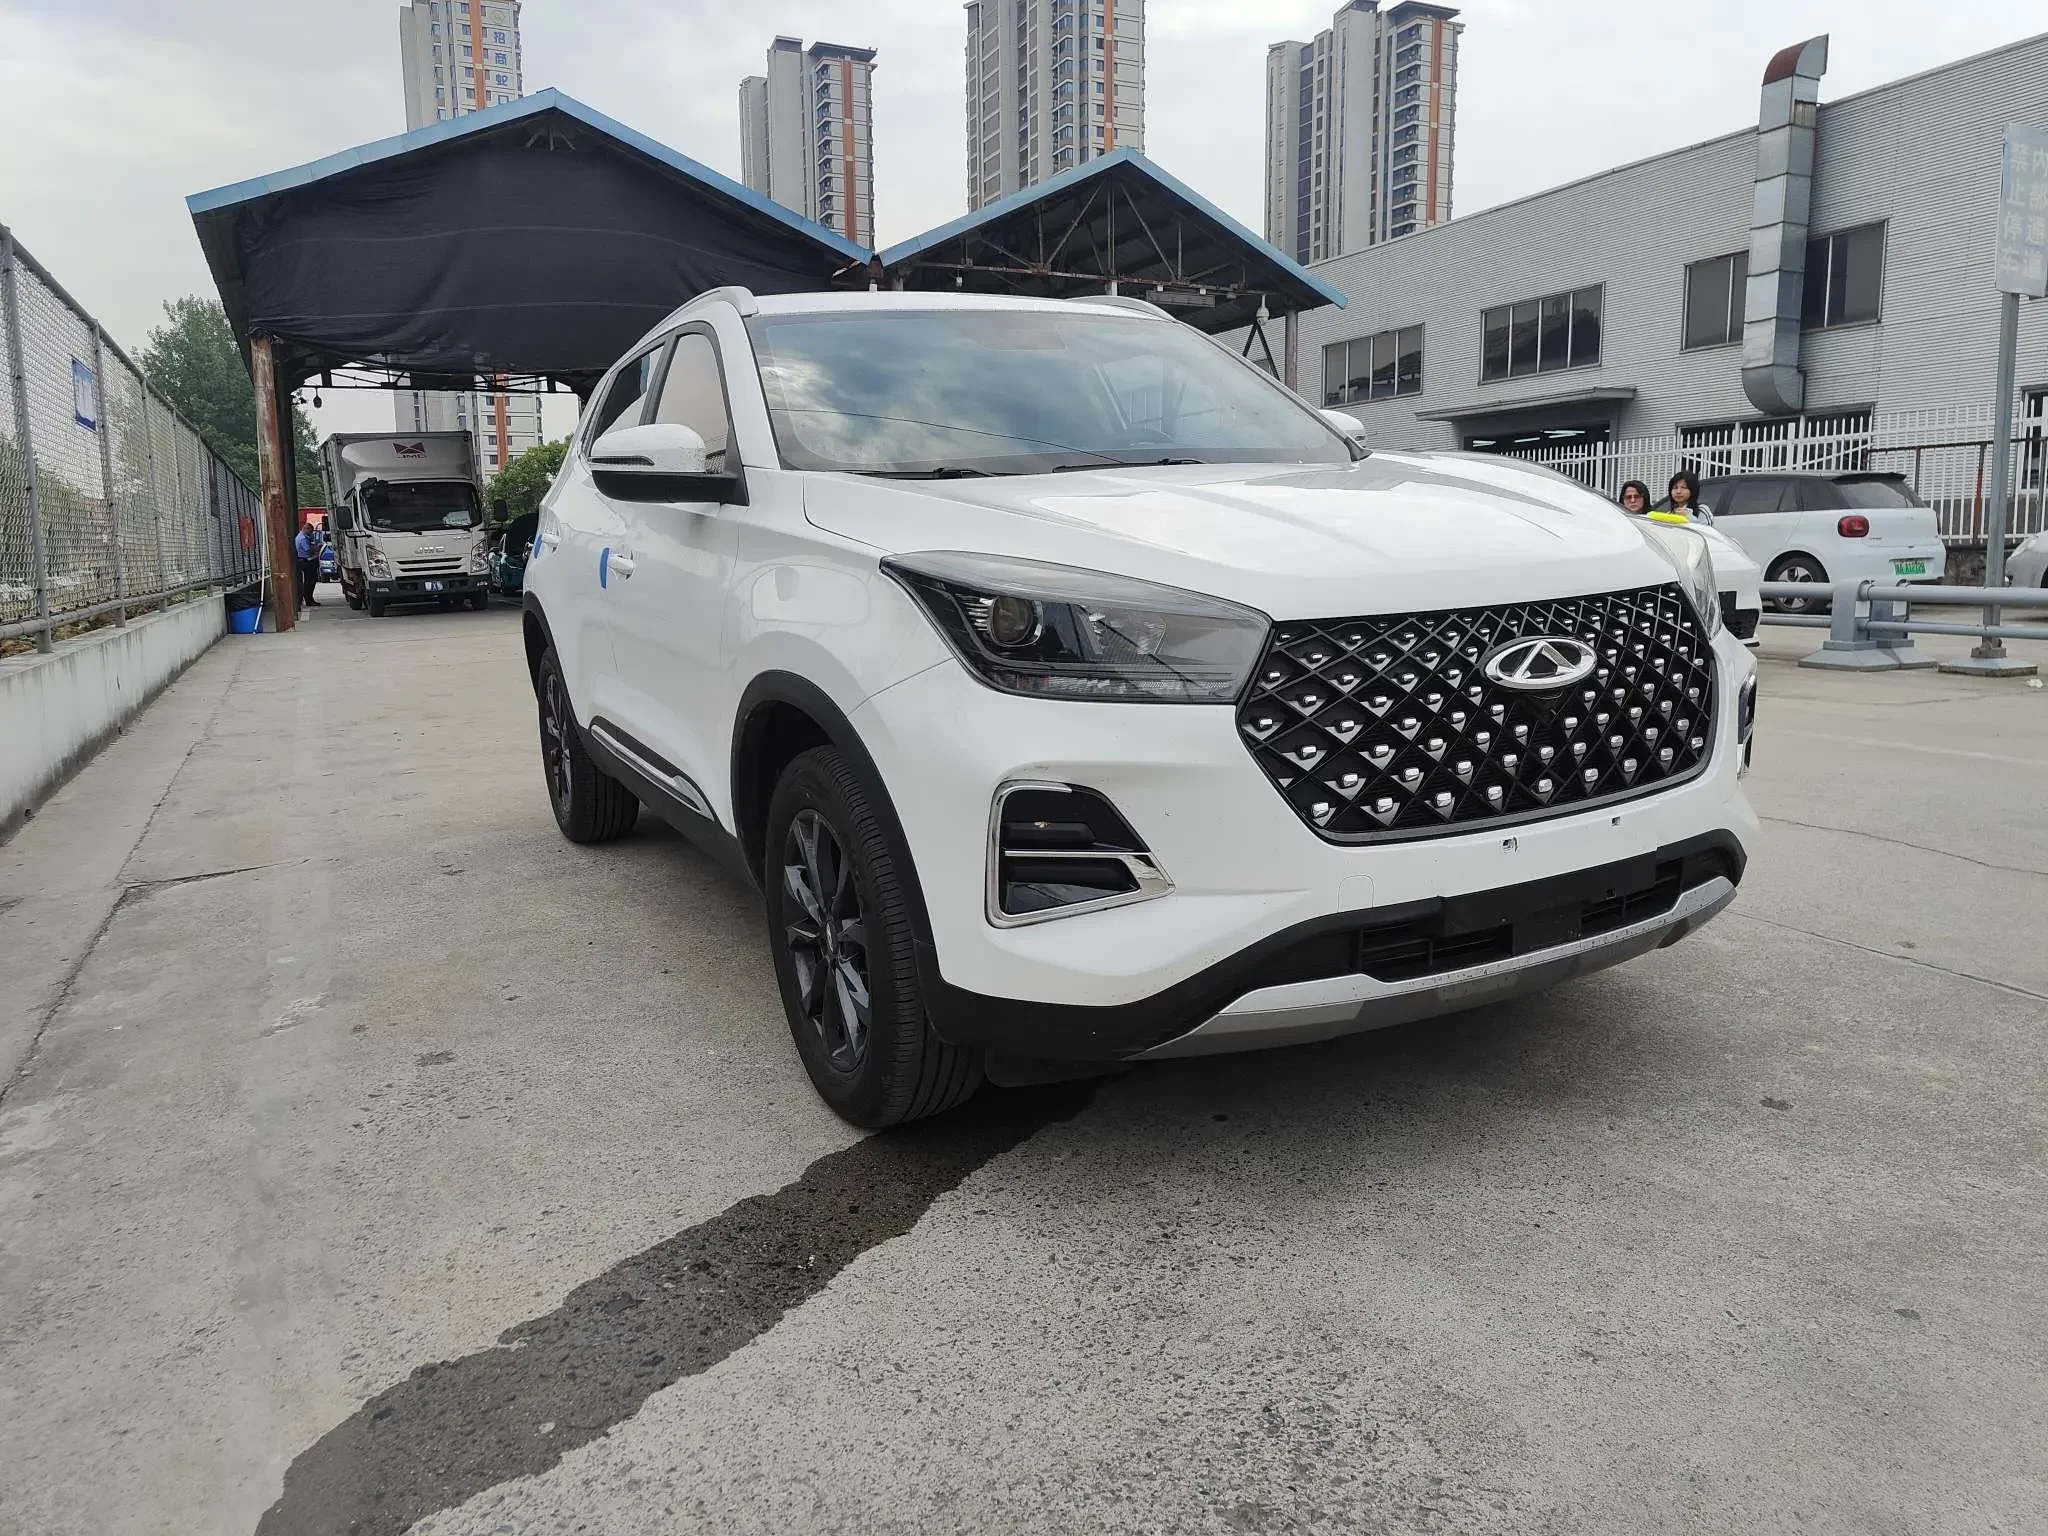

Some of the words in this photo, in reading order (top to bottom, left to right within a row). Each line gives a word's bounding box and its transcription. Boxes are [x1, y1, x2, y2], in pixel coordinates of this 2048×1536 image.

[1999, 142, 2029, 274] 禁止停车
[2021, 146, 2048, 280] 内部通道
